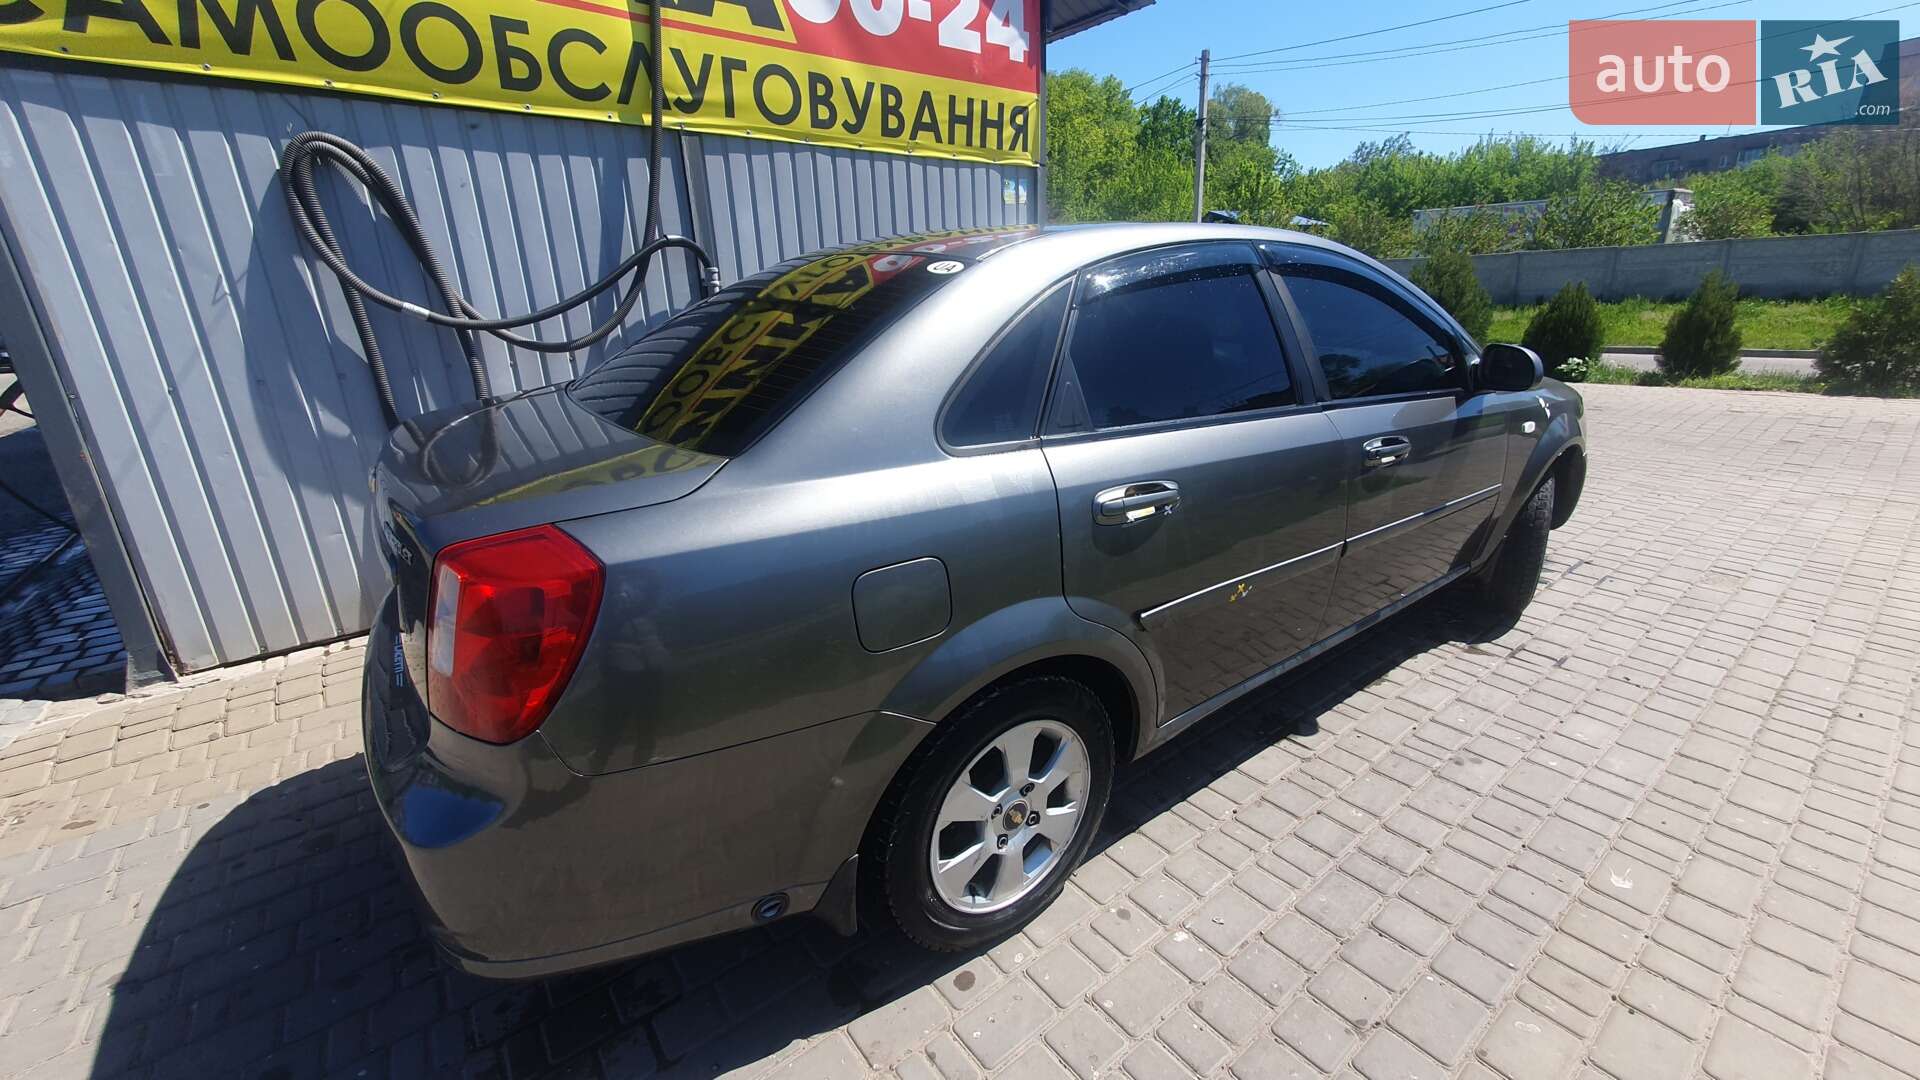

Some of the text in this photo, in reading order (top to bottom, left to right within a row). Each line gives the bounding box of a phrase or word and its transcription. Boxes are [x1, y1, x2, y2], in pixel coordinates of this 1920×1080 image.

[788, 0, 1029, 62] -24
[0, 0, 1029, 152] АМООБСЛУГОВУВАННЯ
[932, 262, 957, 272] UA
